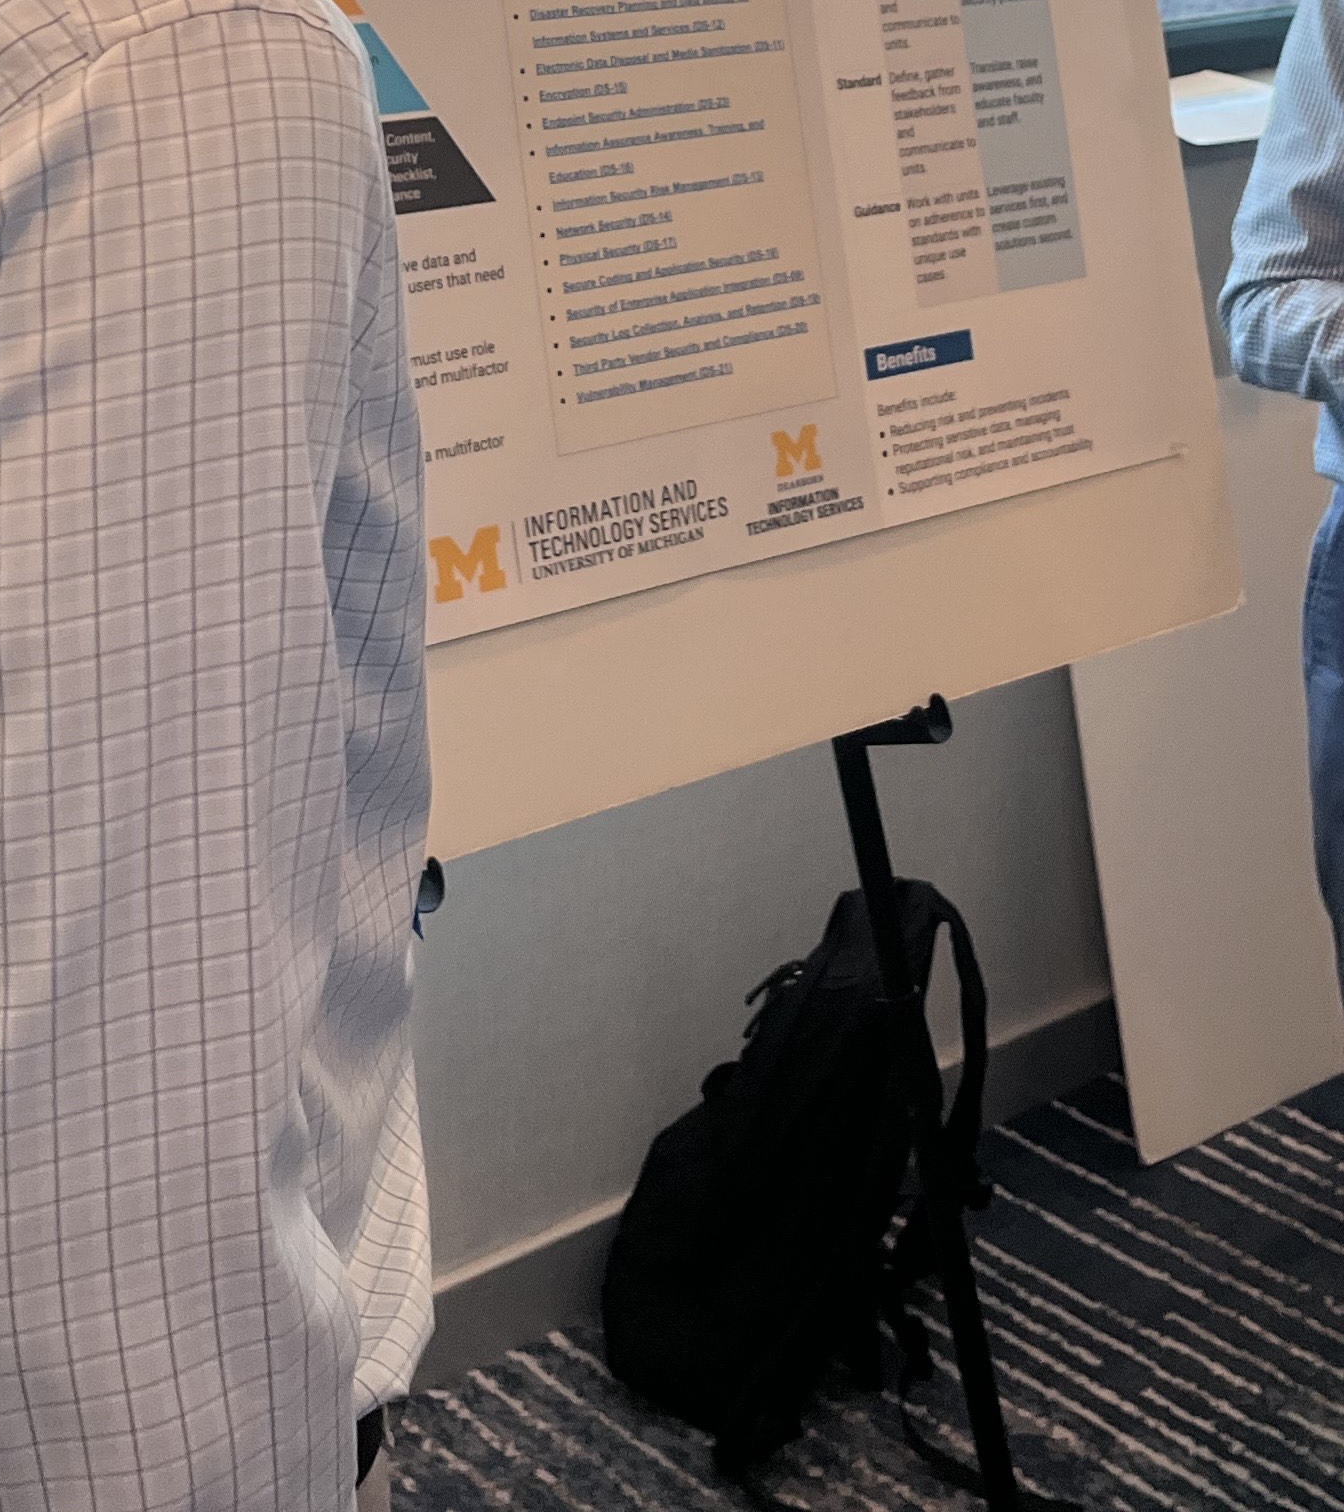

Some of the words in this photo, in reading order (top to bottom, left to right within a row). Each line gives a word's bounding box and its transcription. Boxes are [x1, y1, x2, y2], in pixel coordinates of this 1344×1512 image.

[837, 72, 882, 90] Standard
[854, 202, 901, 218] Guidance
[422, 255, 450, 271] data
[453, 248, 477, 265] and
[408, 277, 443, 294] users
[446, 271, 472, 288] that
[474, 265, 505, 284] need
[410, 351, 443, 368] must
[446, 347, 469, 362] use
[471, 340, 496, 357] role
[876, 345, 937, 372] Benefits
[414, 371, 438, 389] and
[441, 360, 510, 385] multifactor
[424, 450, 433, 463] a
[435, 435, 505, 461] multifactor
[770, 423, 822, 478] M
[524, 488, 656, 538] INFORMATION
[660, 479, 698, 506] AND
[767, 487, 840, 515] INFORMATION
[529, 516, 644, 563] TECHNOLOGY
[649, 496, 729, 534] SERVICES
[745, 509, 814, 536] TECHNOLOGY
[816, 496, 864, 519] SERVICES
[429, 523, 507, 604] M
[532, 548, 615, 580] UNIVERSITY
[618, 543, 635, 559] OF
[638, 526, 705, 555] MICHIGAN
